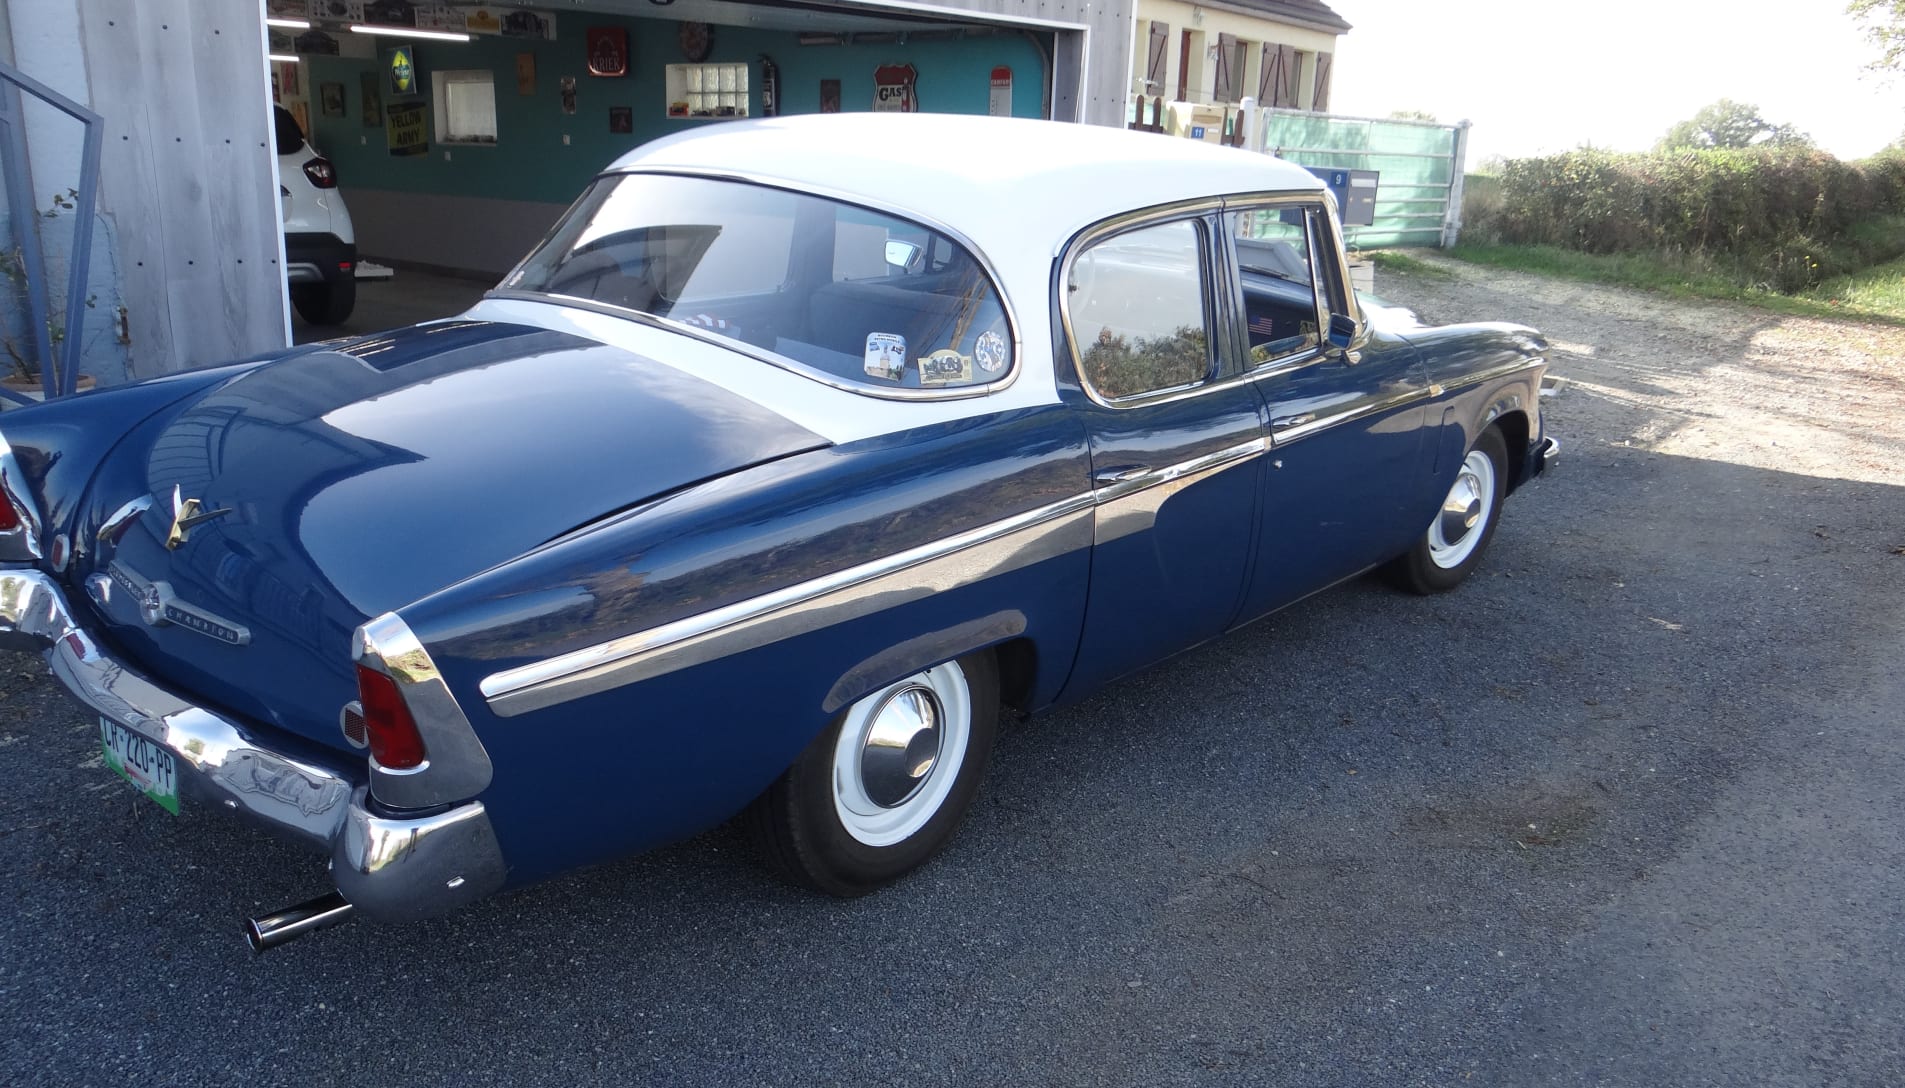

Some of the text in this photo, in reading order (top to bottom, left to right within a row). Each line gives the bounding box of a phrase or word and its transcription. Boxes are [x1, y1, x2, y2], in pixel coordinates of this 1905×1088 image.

[879, 87, 902, 102] GAS
[391, 110, 422, 129] YELLOW
[397, 127, 420, 146] ARMY
[1195, 128, 1202, 137] 11
[1335, 174, 1342, 185] 9
[168, 608, 234, 640] CHAMPION
